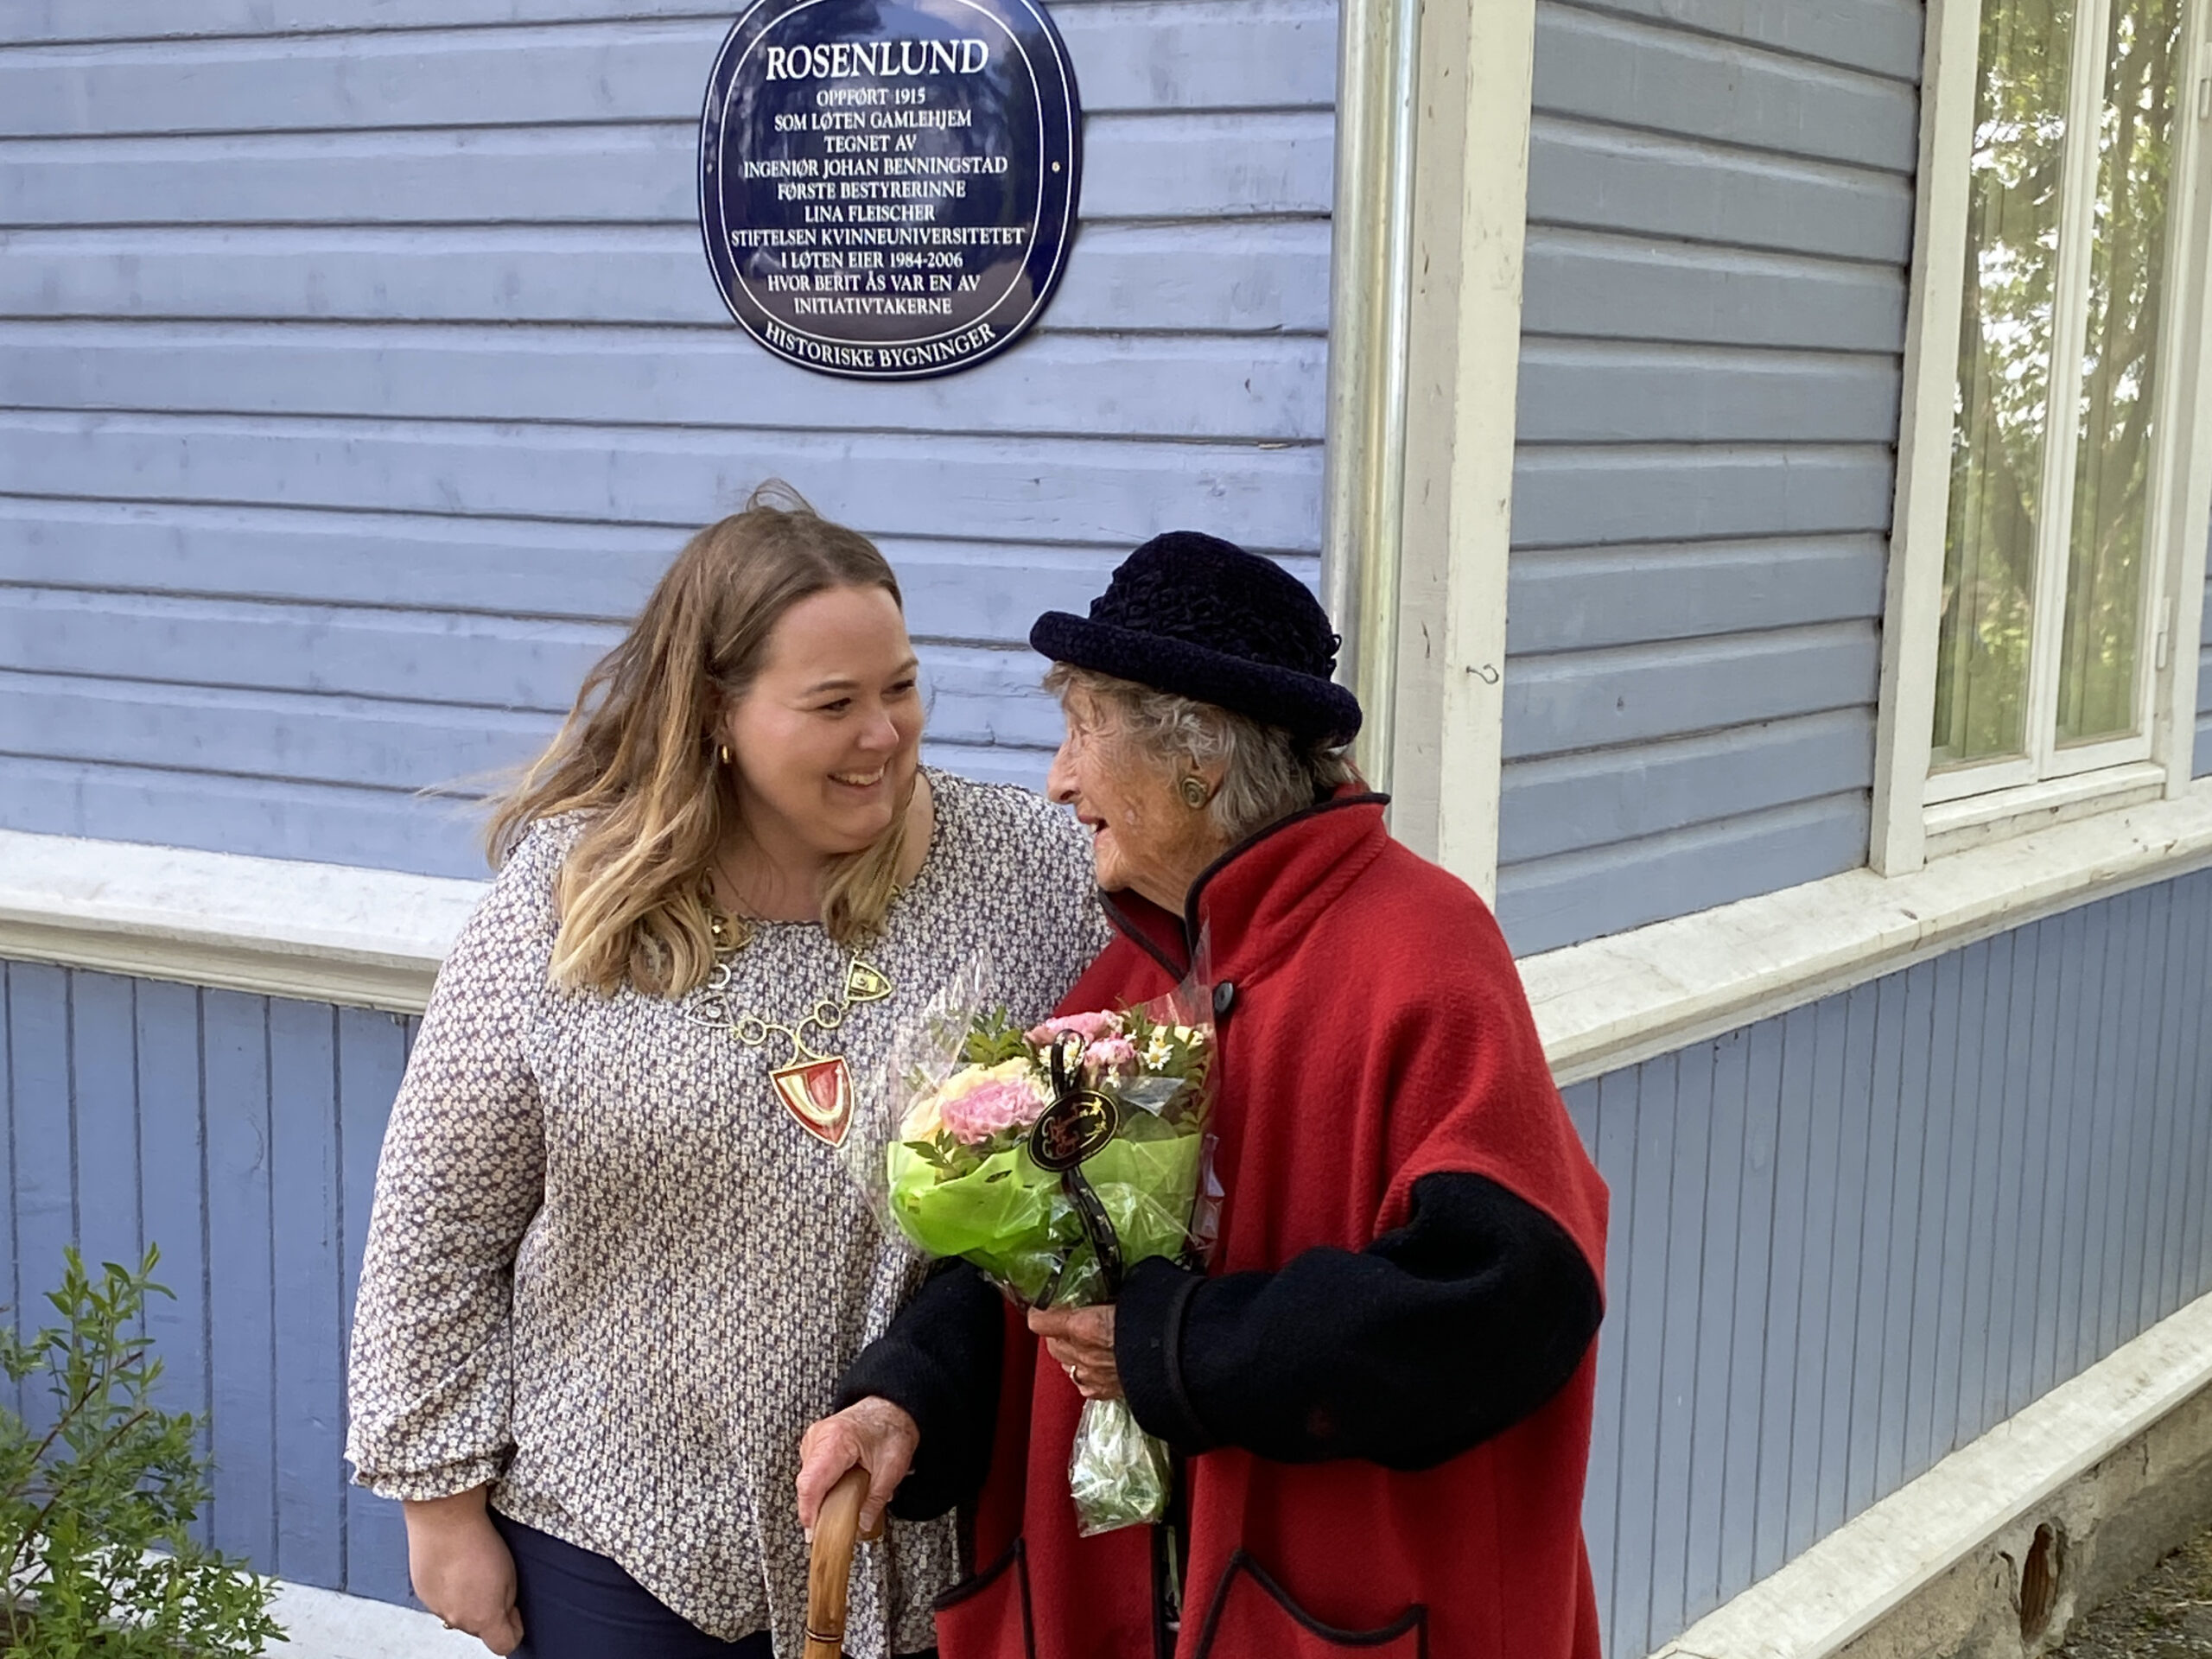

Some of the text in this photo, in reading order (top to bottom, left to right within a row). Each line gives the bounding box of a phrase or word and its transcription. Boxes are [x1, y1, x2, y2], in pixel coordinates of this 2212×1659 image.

[766, 39, 989, 80] ROSENLUND
[817, 87, 925, 106] OPPFØRT 1915
[774, 110, 972, 131] SOM LØTEN GAMLEHJEM
[824, 135, 916, 153] TEGNET AV
[744, 156, 1008, 179] INGENIØR JOHAN BENNINGSTAD
[778, 181, 966, 200] FØRSTE BESTYRERINNE
[805, 205, 935, 223] LINA FLEISCHER
[731, 227, 1025, 247] STIFTELSEN KVINNEUNIVERSITETET
[781, 251, 963, 269] I LØTEN EIER 1984-2006
[767, 270, 981, 292] HVOR BERIT ÅS VAR EN AV
[793, 297, 952, 315] INITIATIVTAKERNE
[765, 321, 996, 367] HISTORISKE BYGNINGER
